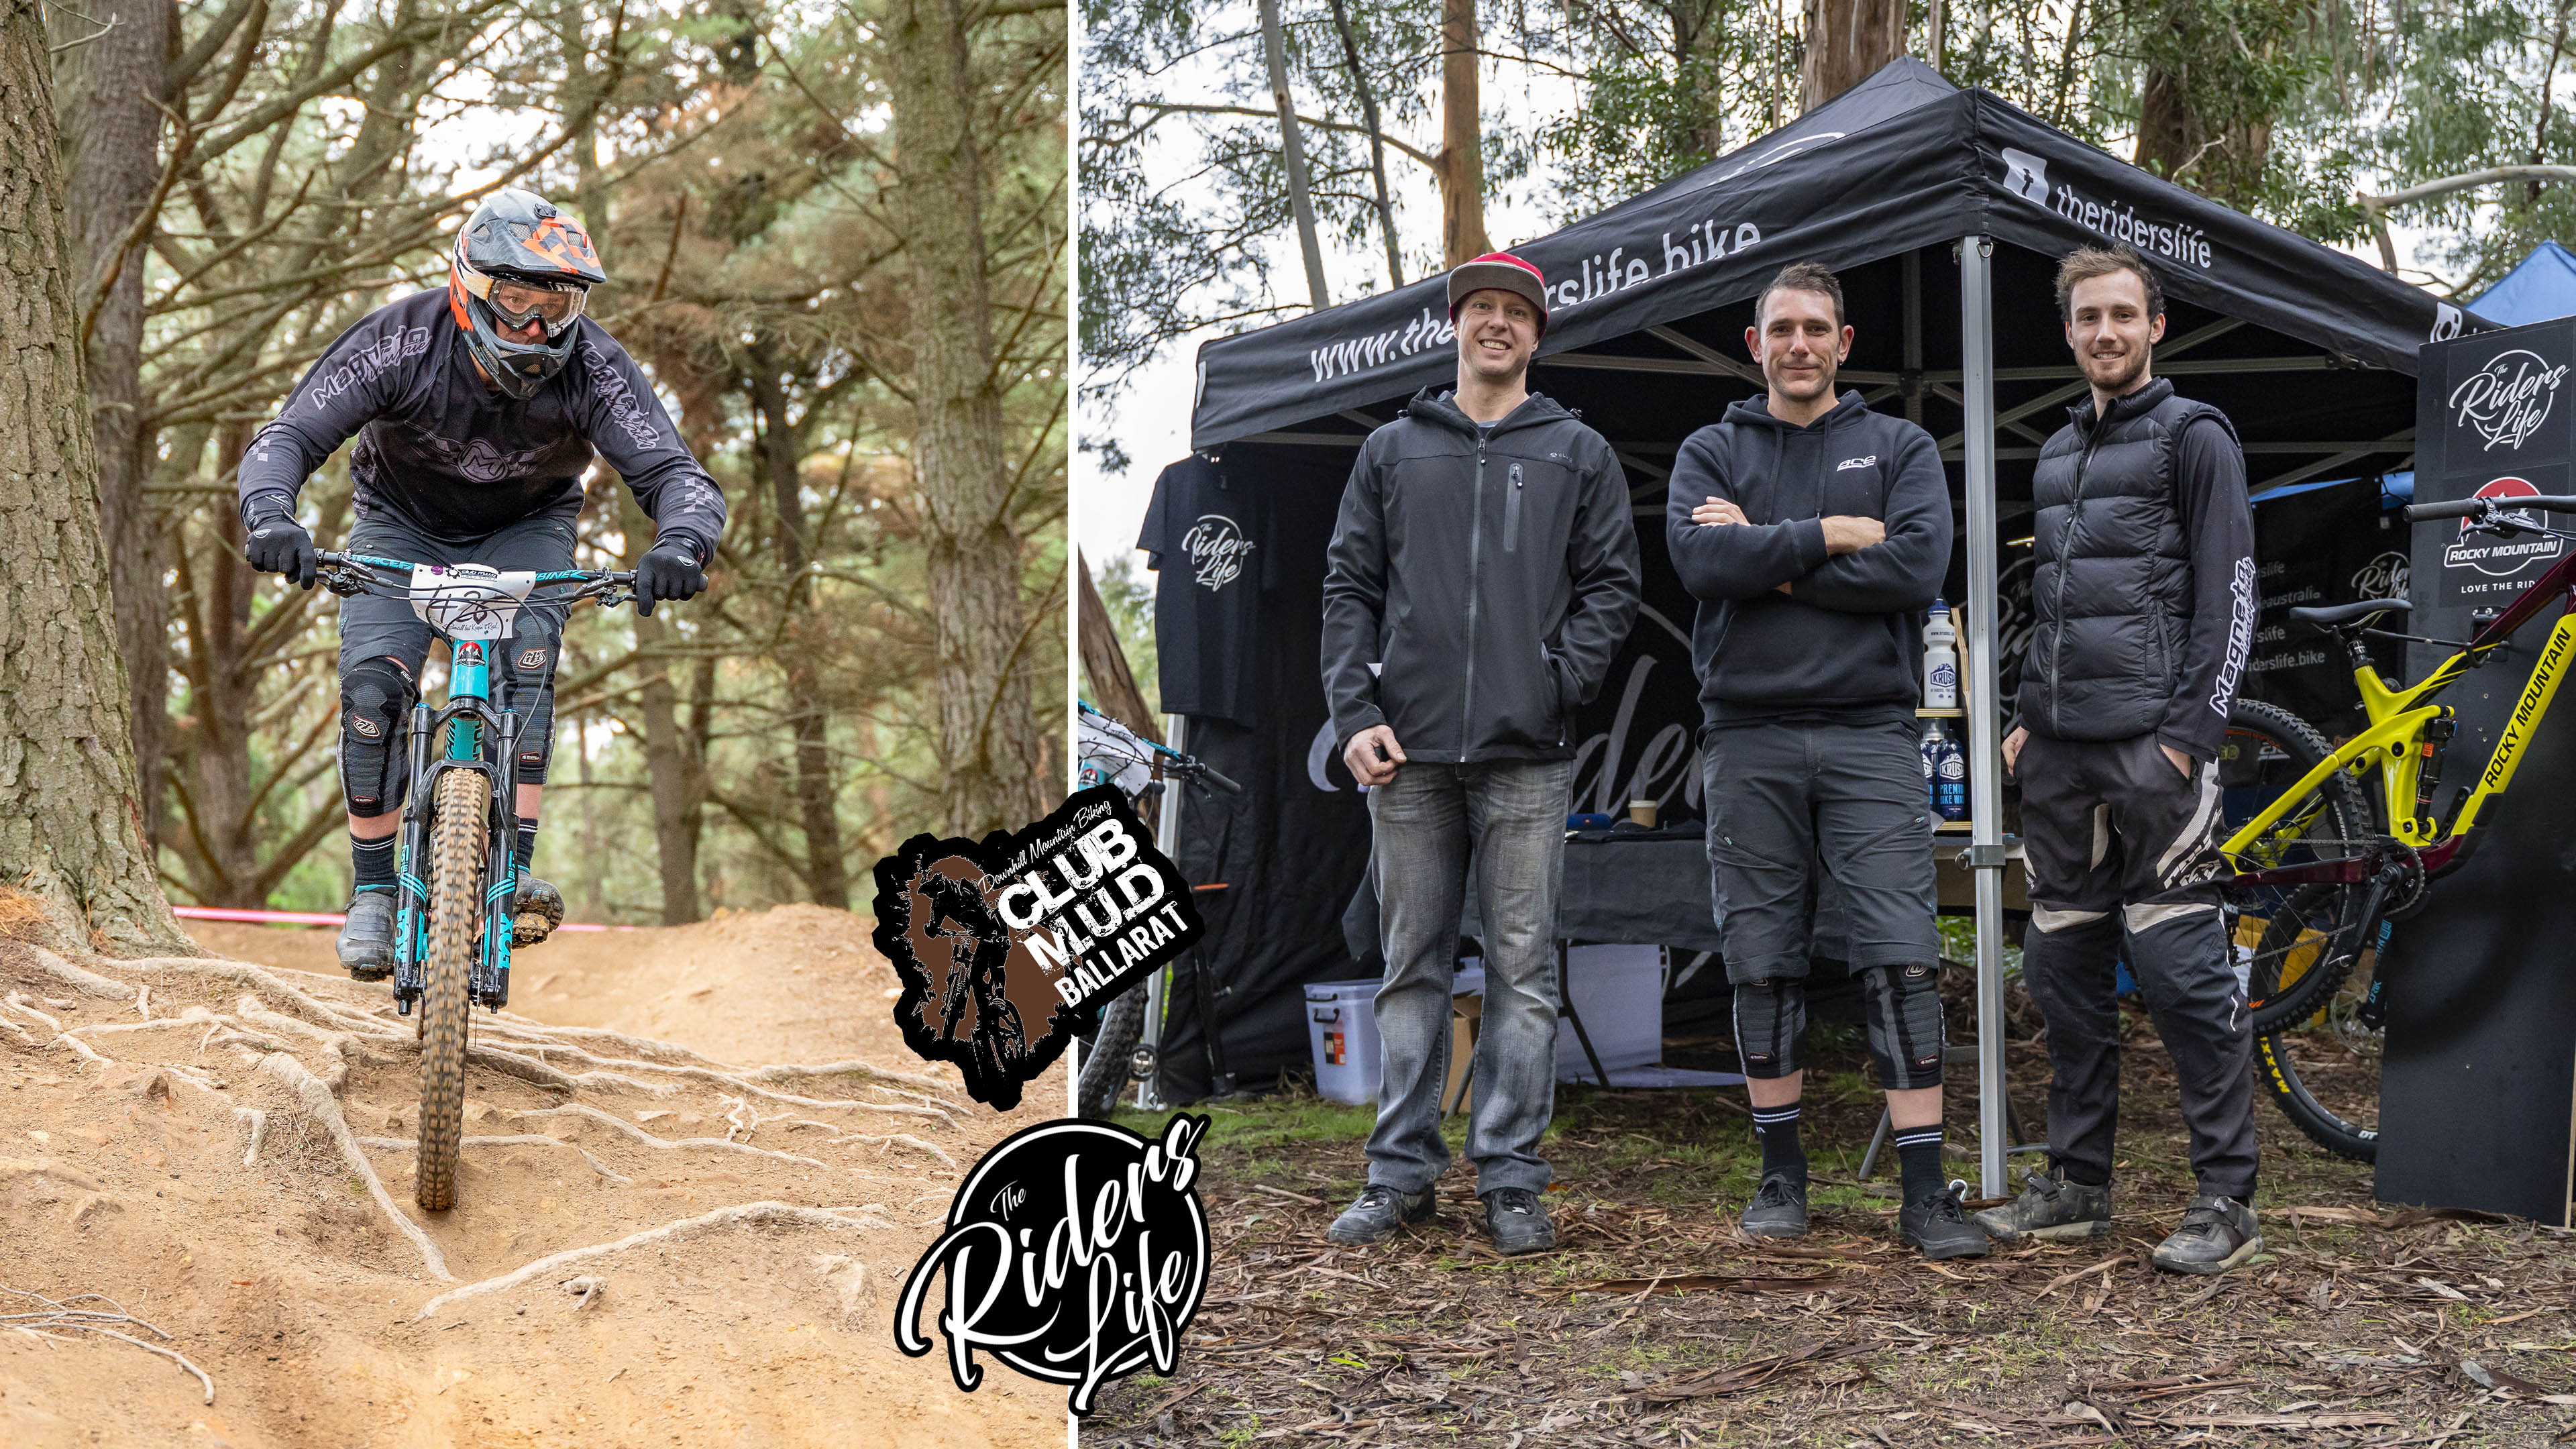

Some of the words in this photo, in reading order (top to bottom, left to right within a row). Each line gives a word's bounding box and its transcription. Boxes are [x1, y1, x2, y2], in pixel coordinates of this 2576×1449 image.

[2057, 184, 2211, 268] theriderslife
[2449, 362, 2571, 427] Riders
[2484, 398, 2542, 451] Life
[1181, 527, 1256, 564] Riders
[2449, 547, 2490, 561] ROCKY
[2491, 541, 2557, 557] MOUNTAIN
[1196, 554, 1238, 592] Life
[2461, 584, 2488, 594] LOVE
[2492, 582, 2512, 591] THE
[2517, 580, 2540, 589] RID
[2209, 559, 2247, 718] Magneto
[400, 671, 413, 683] RIGHT
[2247, 651, 2326, 672] iderslife.bike
[2485, 724, 2519, 788] ROCKY
[2516, 627, 2571, 727] MOUNTAIN
[1940, 795, 1952, 804] BIKE
[1953, 795, 1964, 804] WA
